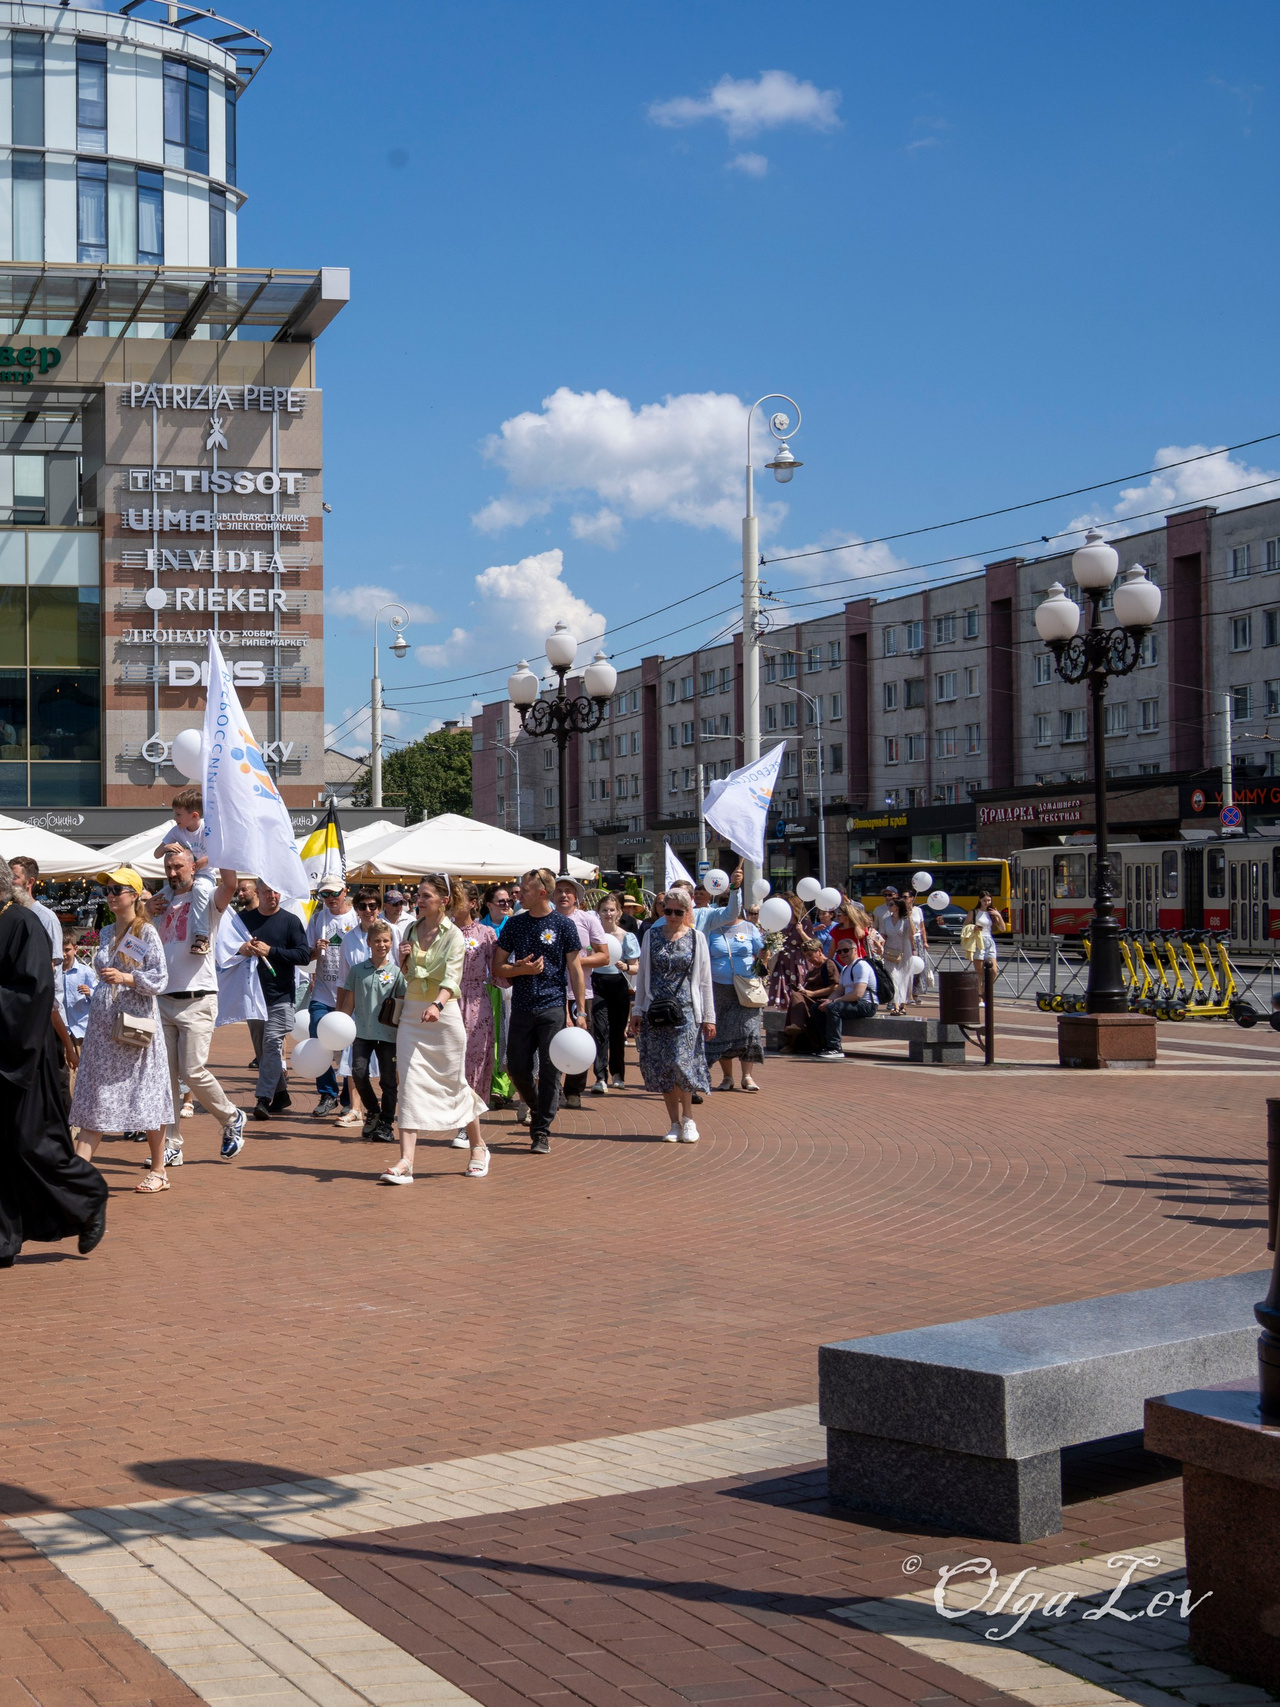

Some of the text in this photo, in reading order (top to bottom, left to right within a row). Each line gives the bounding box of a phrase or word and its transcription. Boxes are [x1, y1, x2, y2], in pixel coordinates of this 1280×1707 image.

[130, 381, 301, 412] PATRIZIA PEPE
[176, 470, 303, 495] TISSOT
[264, 514, 305, 522] ТЕХНИКА
[226, 522, 292, 531] ЭЛЕКТРОНИКА
[145, 548, 288, 573] INVIDIA
[176, 588, 288, 612] RIEKER
[124, 629, 234, 643] ЛЕОНАРО
[241, 639, 308, 647] ГИПЕРМАРКЕТ
[1038, 800, 1080, 811] ДОМАШНЕГО
[1215, 788, 1267, 807] YMMY
[980, 806, 1035, 825] ЯРМАРКА
[1038, 811, 1080, 822] ТЕКСТИЛЯ
